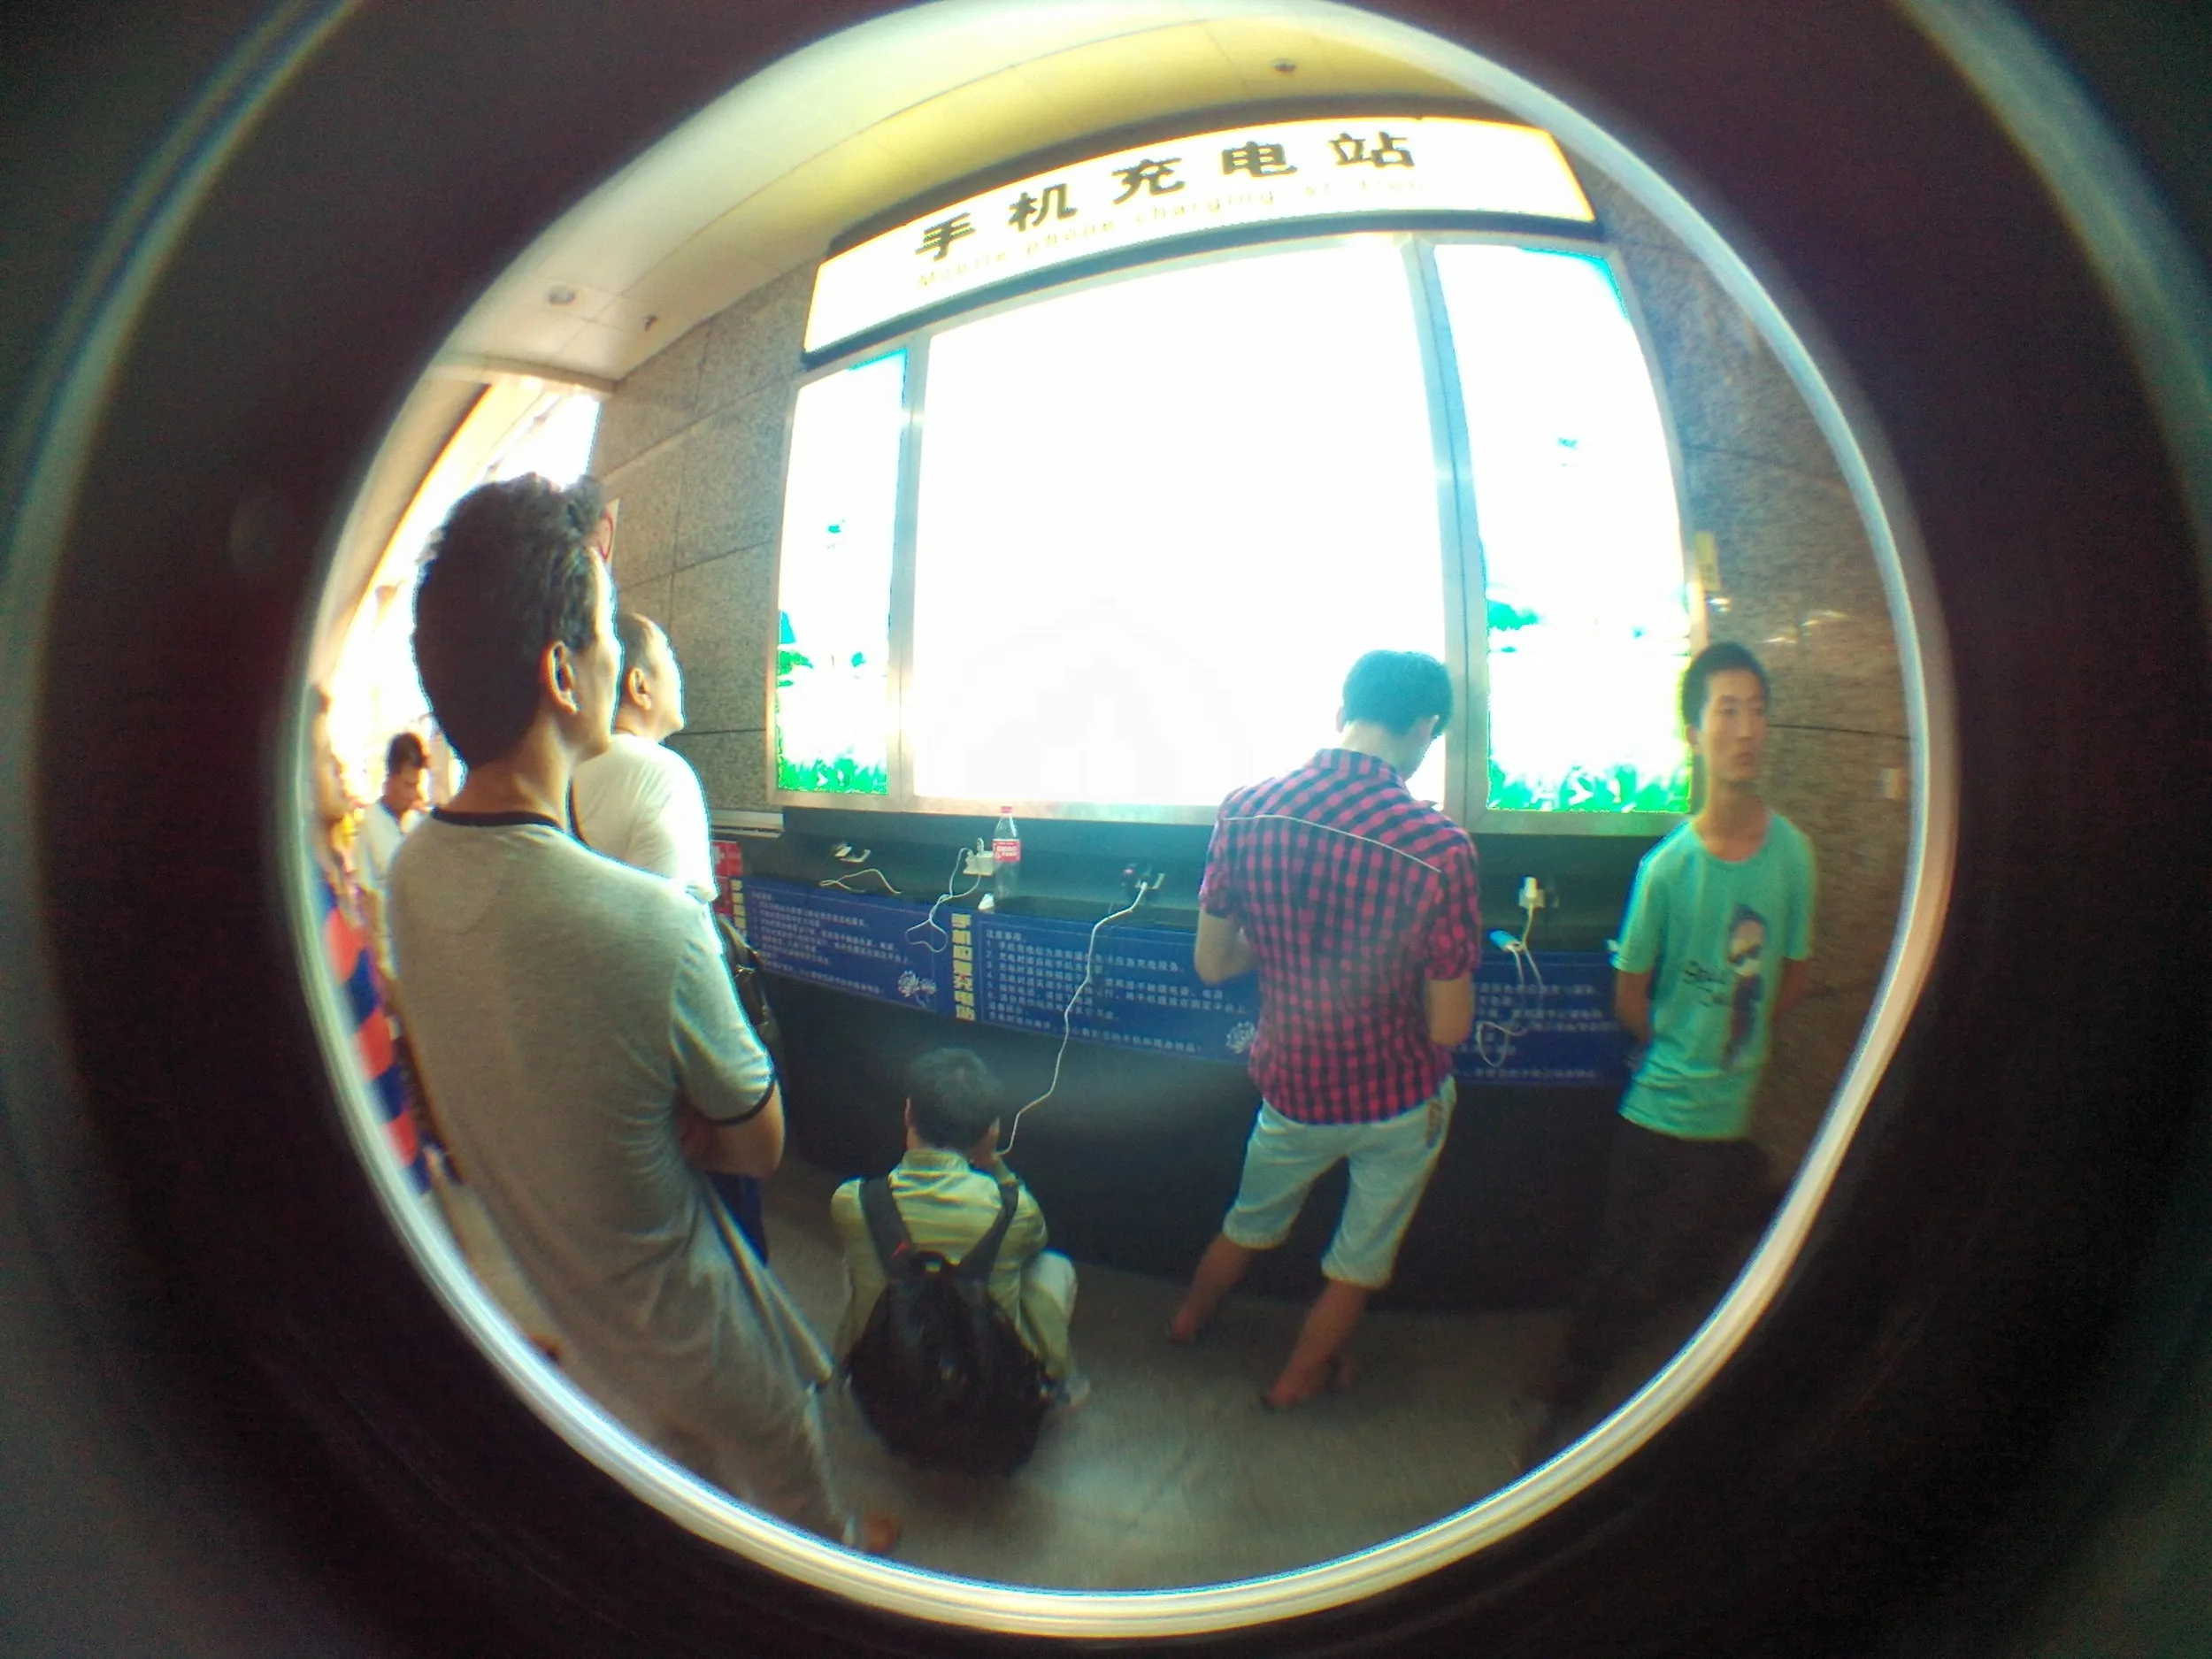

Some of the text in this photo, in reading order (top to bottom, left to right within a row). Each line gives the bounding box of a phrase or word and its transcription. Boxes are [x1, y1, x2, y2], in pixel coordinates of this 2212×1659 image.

[915, 130, 1417, 261] 手机充电站
[1024, 221, 1116, 257] phone
[1133, 192, 1272, 225] charging
